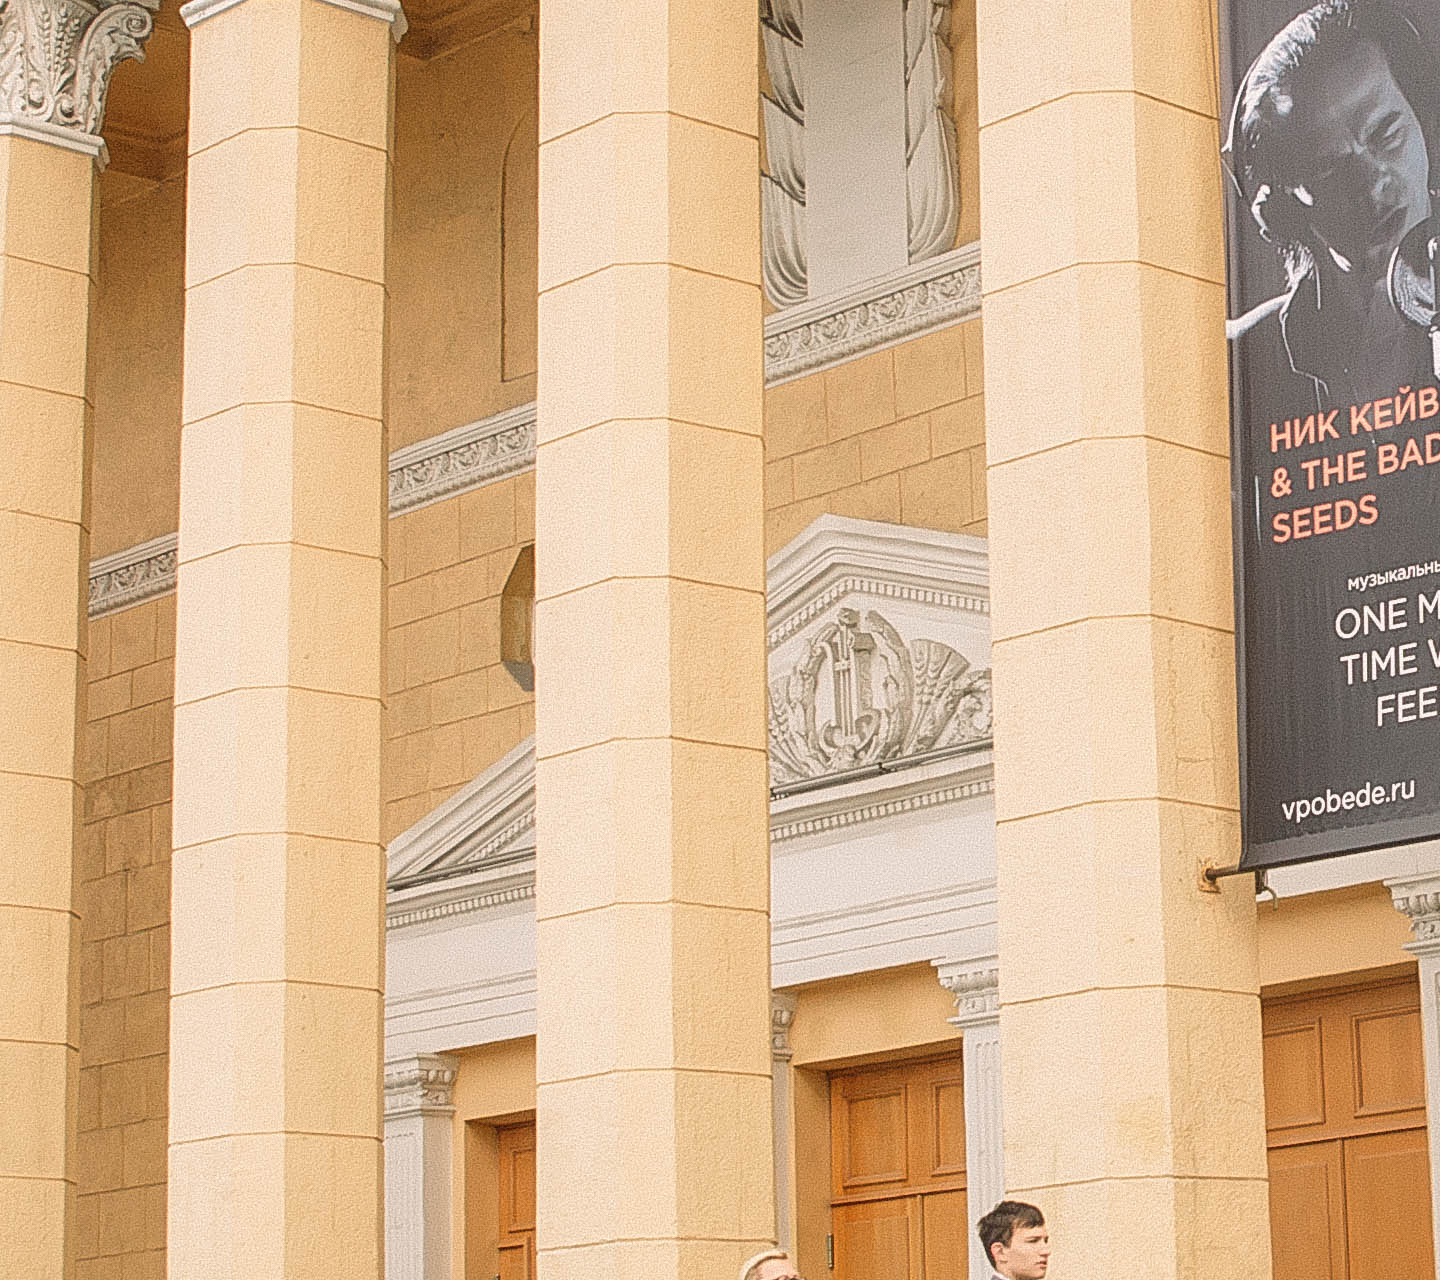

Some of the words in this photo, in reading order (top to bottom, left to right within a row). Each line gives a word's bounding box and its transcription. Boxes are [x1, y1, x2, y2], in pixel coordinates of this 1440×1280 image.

[1269, 409, 1340, 453] НИК
[1350, 385, 1440, 435] КЕЙВ
[1271, 467, 1292, 498] &
[1300, 450, 1367, 490] THE
[1272, 494, 1379, 544] SEEDS
[1335, 597, 1408, 640] ONE
[1340, 642, 1418, 685] TIME
[1282, 780, 1415, 823] vpobede.ru
